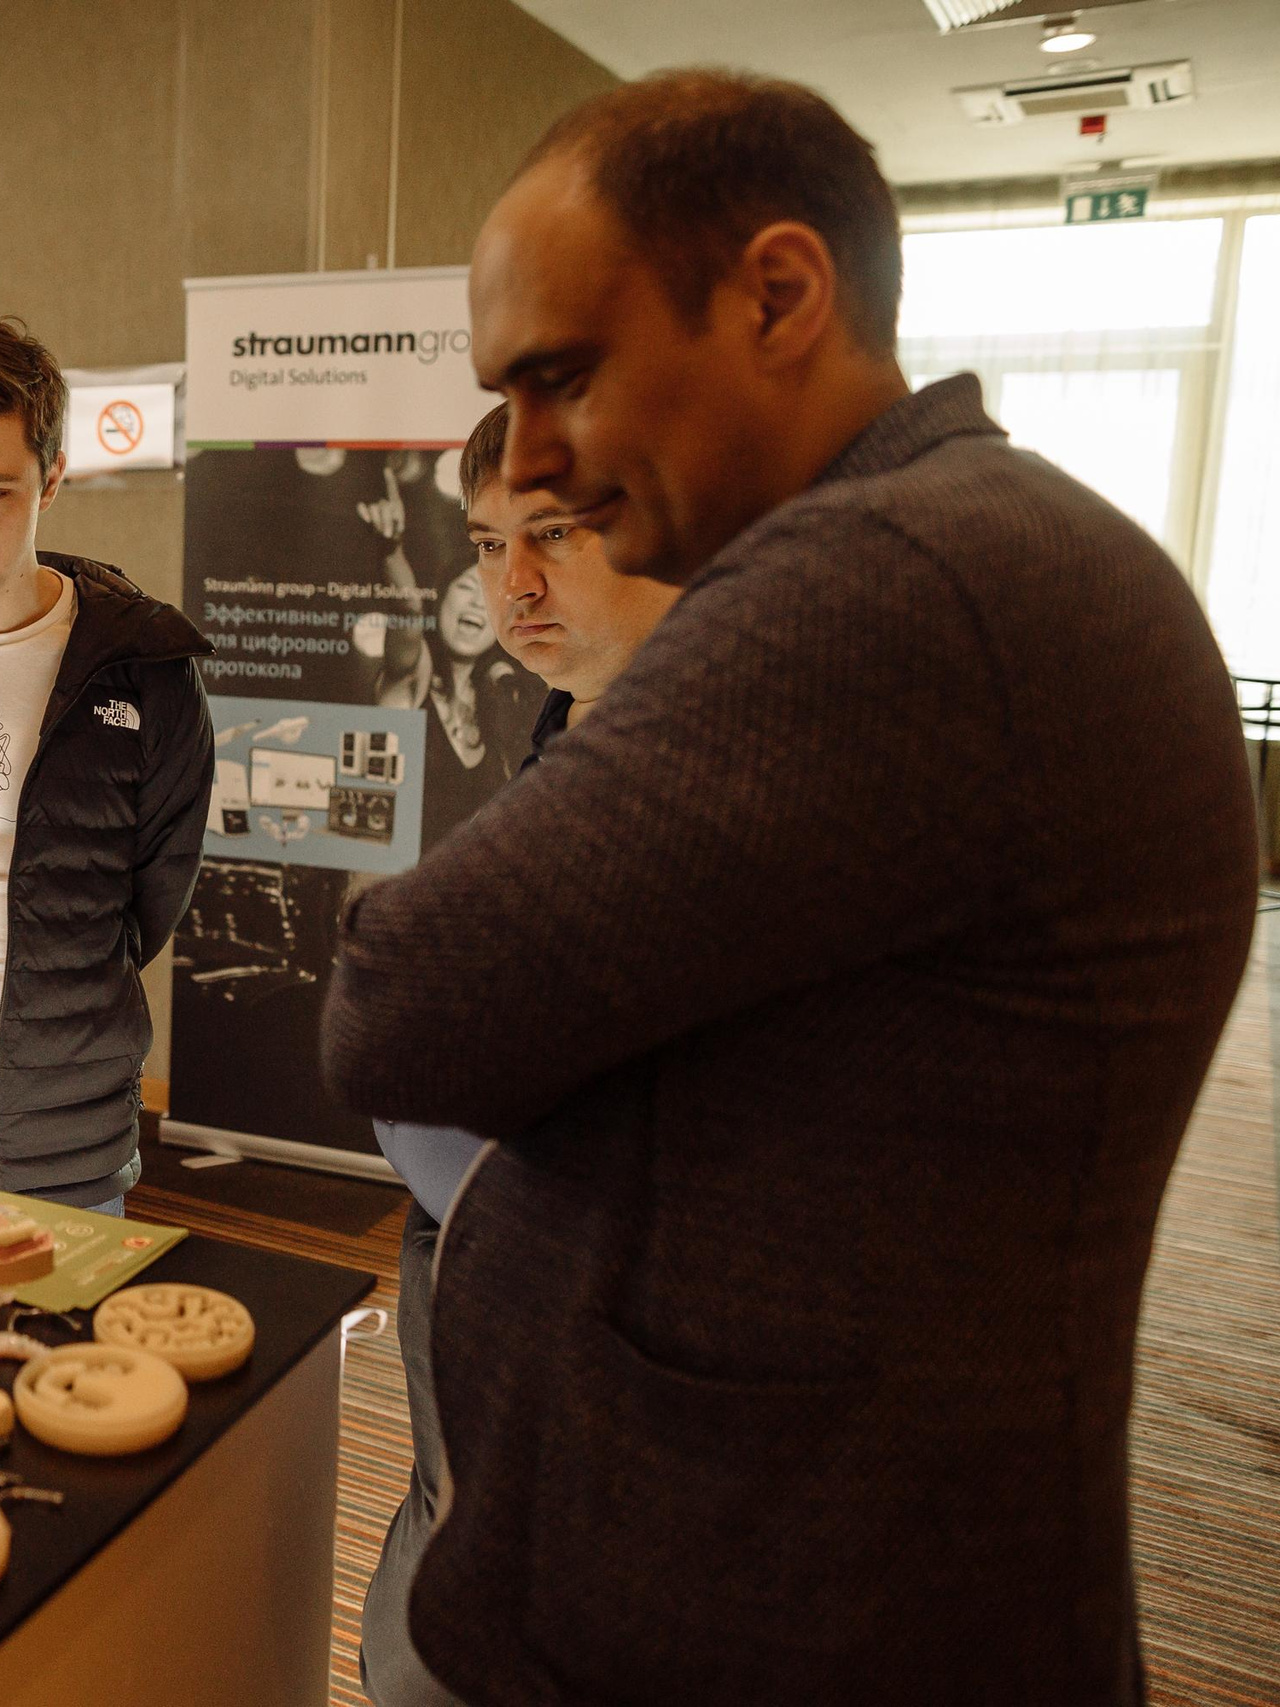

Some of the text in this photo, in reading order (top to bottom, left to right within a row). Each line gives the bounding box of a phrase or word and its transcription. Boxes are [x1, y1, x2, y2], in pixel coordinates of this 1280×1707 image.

[230, 367, 367, 390] Digital Solutions
[275, 582, 315, 599] group
[327, 581, 372, 601] Digital
[242, 632, 349, 656] цифрового
[203, 659, 302, 680] протокола
[93, 705, 127, 719] NORTH
[109, 699, 127, 710] THE
[103, 715, 127, 727] FACE
